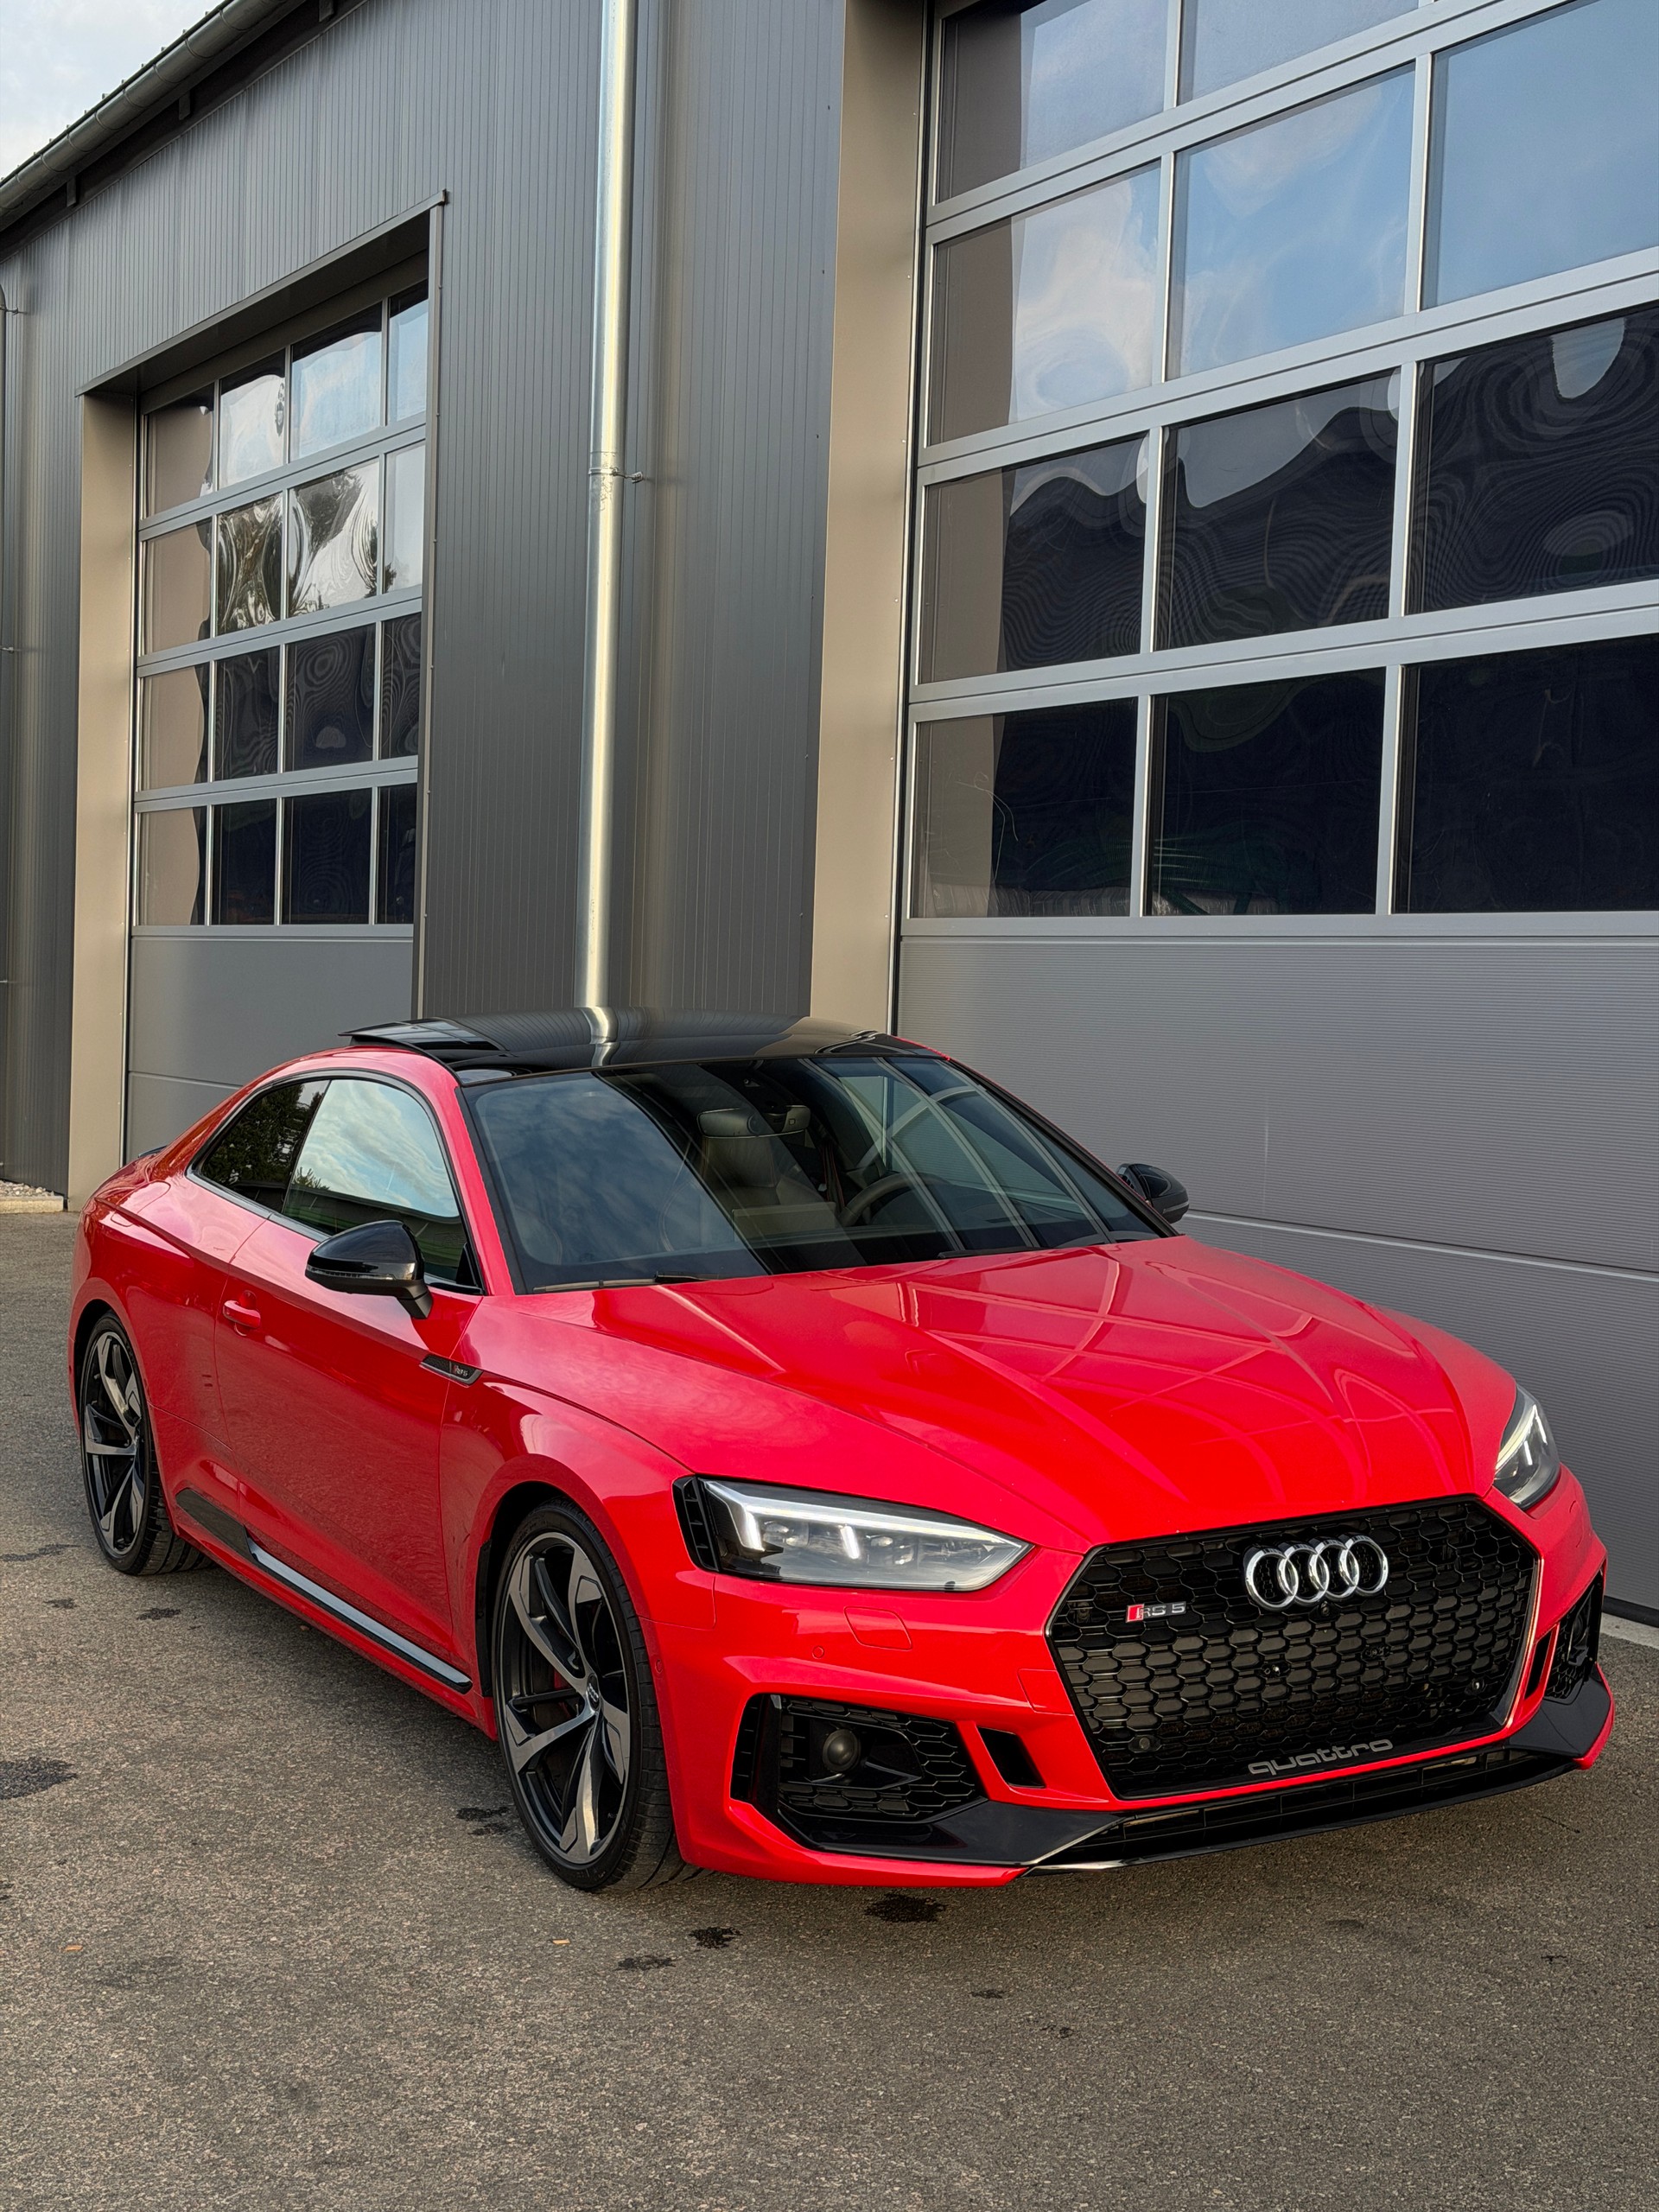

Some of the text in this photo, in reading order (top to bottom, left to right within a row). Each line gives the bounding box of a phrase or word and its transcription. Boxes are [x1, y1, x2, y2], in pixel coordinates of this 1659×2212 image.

[1133, 1604, 1185, 1619] RS 5
[1248, 1738, 1393, 1775] quattro
